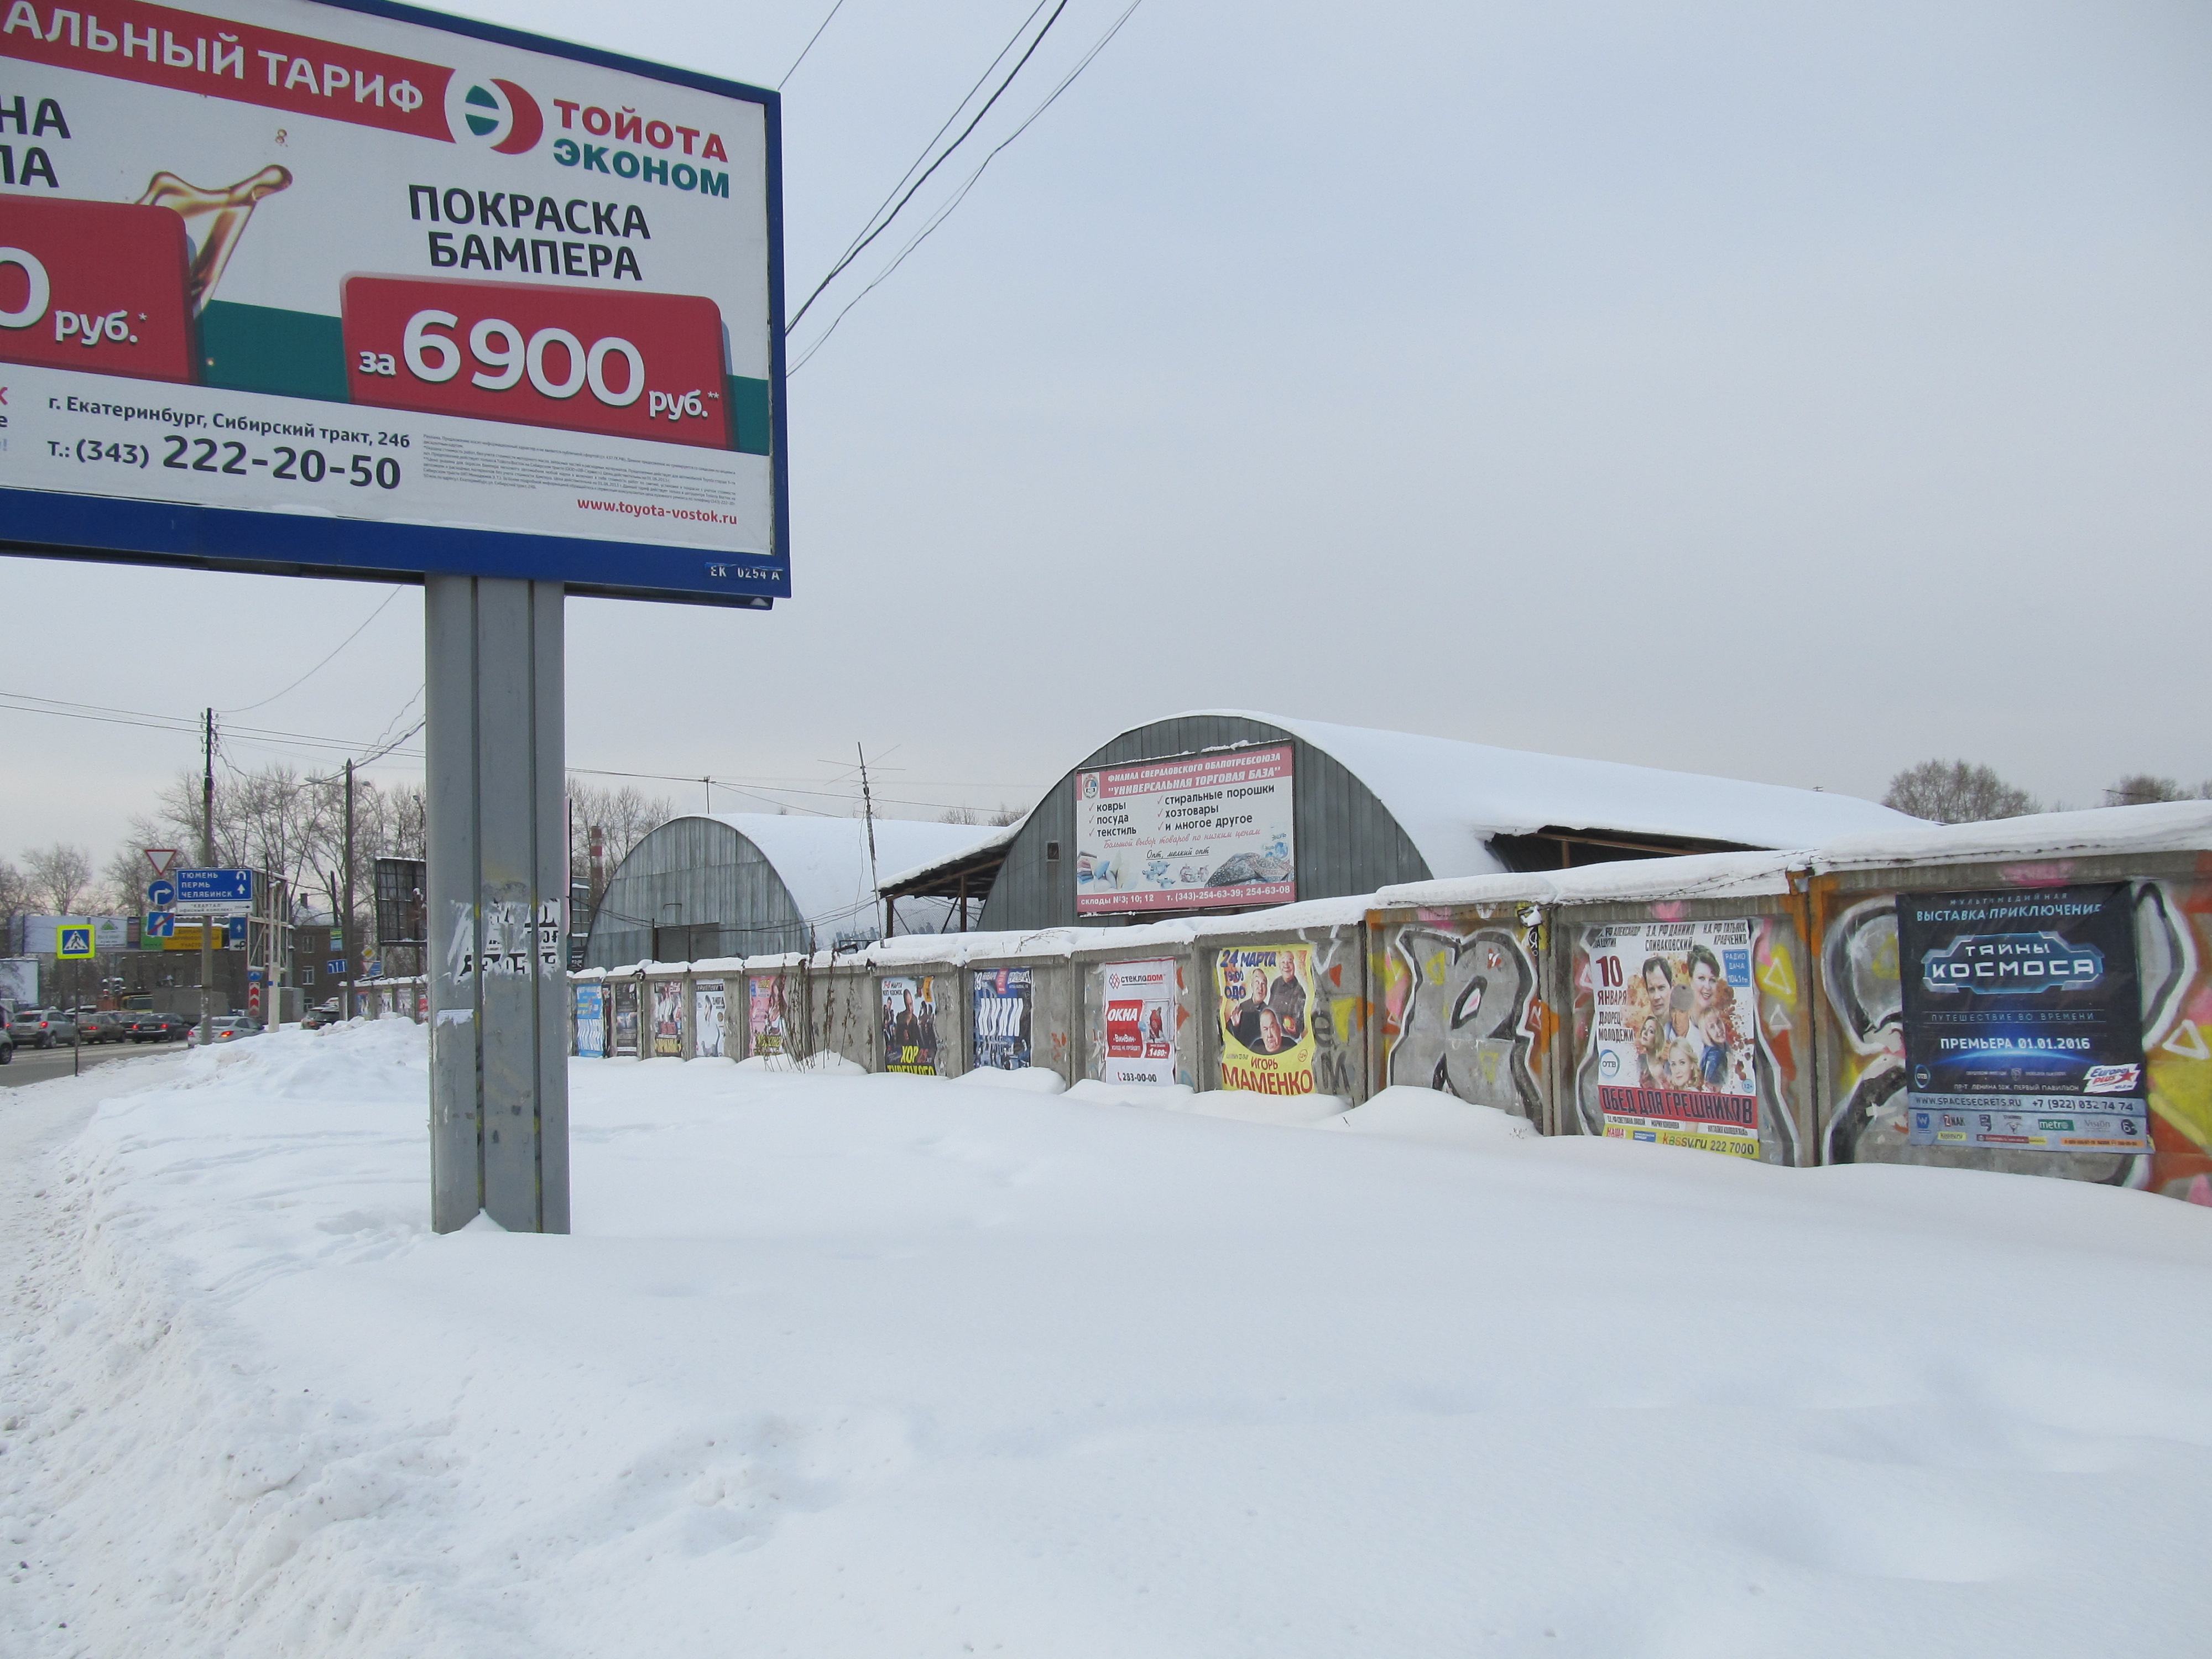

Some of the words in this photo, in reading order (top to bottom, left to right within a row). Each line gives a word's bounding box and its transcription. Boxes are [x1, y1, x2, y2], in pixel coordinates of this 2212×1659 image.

[2, 1, 244, 79] АЛЬНЫЙ
[258, 49, 424, 113] ТАРИФ
[554, 99, 729, 163] ТОЙОТА
[554, 138, 729, 198] ЭКОНОМ
[408, 184, 651, 239] ПОКРАСКА
[428, 231, 643, 281] БАМПЕРА
[358, 351, 395, 377] за
[403, 309, 645, 406] 6900
[49, 396, 61, 411] г.
[66, 396, 208, 429] Екатеринбург,
[212, 413, 315, 439] Сибирский
[320, 425, 374, 447] тракт,
[378, 431, 411, 448] 246
[76, 438, 150, 468] (343)
[163, 435, 401, 489] 222-20-50
[577, 499, 738, 525] www.toyota-vostok.ru
[737, 567, 766, 580] 0254
[1140, 764, 1203, 779] СВЕРДЛОВСКОГО
[1205, 753, 1281, 770] ОБЛПОТРЕБСОЮЗА
[1195, 771, 1245, 785] ТОРГОВАЯ
[1165, 791, 1223, 808] стиральные
[1227, 785, 1275, 800] порошки
[1096, 801, 1126, 813] ковры
[1165, 805, 1219, 819] хозтовары
[1097, 815, 1129, 827] посуда
[1165, 822, 1171, 831] и
[1175, 817, 1212, 830] многое
[1215, 814, 1253, 828] другое
[1097, 827, 1137, 837] текстиль
[1103, 838, 1134, 849] Большой
[1135, 836, 1157, 848] выбор
[1159, 834, 1190, 845] товаров
[1204, 831, 1233, 840] низким
[1235, 828, 1261, 839] ценам
[1146, 848, 1164, 860] Опт,
[1167, 847, 1193, 857] мелкий
[1195, 847, 1210, 856] опт
[1081, 897, 1112, 906] склады
[1113, 896, 1129, 905] №3;
[1130, 895, 1142, 904] 10;
[1144, 894, 1155, 902] 12
[1175, 889, 1244, 902] (343)-254-63-39;
[1246, 885, 1291, 896] 254-63-08
[1949, 893, 2068, 905] МУЛЬТИМЕДИЙНАЯ
[1658, 925, 1667, 936] РФ
[1668, 924, 1695, 936] ДАНИИЛ
[1645, 936, 1693, 951] СПИВАКОВСКИЙ
[1713, 933, 1747, 945] КРАВЧЕНКО
[1964, 943, 2051, 957] ТАЙНЫ
[1220, 949, 1239, 967] 24
[1240, 951, 1277, 967] МАРТА
[1595, 955, 1623, 987] 10
[1932, 959, 2095, 978] КОСМОСА
[1224, 985, 1246, 1000] ОДО
[1598, 990, 1627, 1006] ЯНВАРЯ
[1107, 1008, 1139, 1021] ОКНА
[1599, 1011, 1621, 1026] ДВОРЕЦ
[1932, 1013, 2013, 1022] ПУТЕШЕСТВИЕ
[2018, 1013, 2033, 1021] ВО
[2041, 1012, 2094, 1020] ВРЕМЕНИ
[1598, 1027, 1634, 1044] МОЛОДЕЖИ
[1940, 1038, 2013, 1050] ПРЕМЬЕРА
[2018, 1037, 2091, 1050] 01.01.2016
[900, 1045, 919, 1063] ХОР
[1251, 1056, 1279, 1070] ИГОРЬ
[1122, 1072, 1157, 1082] 283-00-00
[1221, 1063, 1313, 1095] МАМЕНКО
[2090, 1068, 2128, 1078] Europa
[1602, 1087, 1637, 1114] ОБЕД
[1637, 1090, 1665, 1115] ДЛЯ
[1665, 1092, 1753, 1125] ГРЕШНИКОВ
[1915, 1097, 2022, 1107] WWW.SPACESECRETS.RU
[2032, 1099, 2043, 1108] +7
[2048, 1099, 2076, 1110] (922)
[2078, 1100, 2100, 1109] 032
[2102, 1100, 2115, 1110] 74
[2117, 1102, 2133, 1111] 74
[1944, 1114, 1965, 1126] ZNAK
[2039, 1120, 2069, 1129] metro
[1662, 1133, 1708, 1149] kassv.ru
[1710, 1140, 1727, 1152] 222
[1730, 1142, 1755, 1155] 7000
